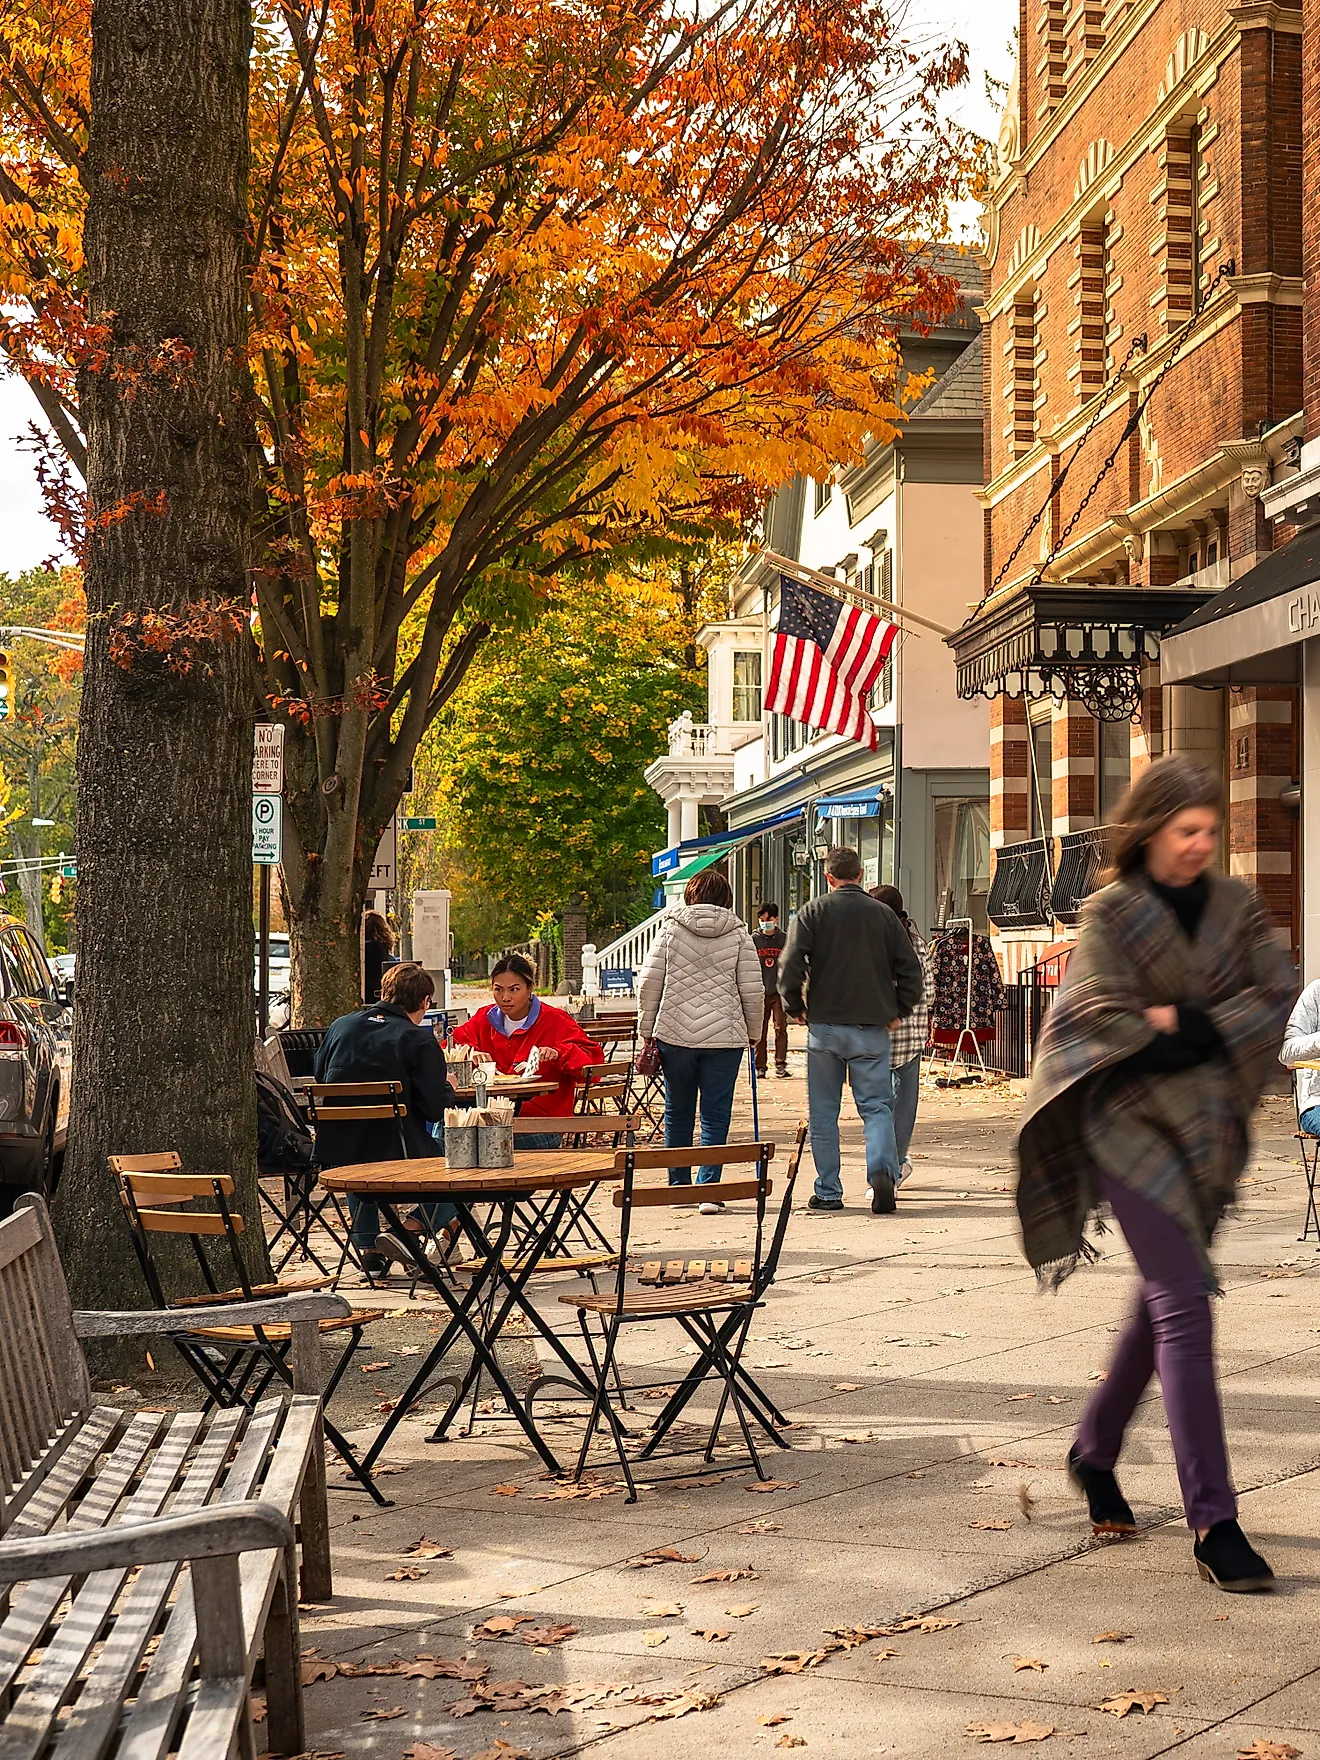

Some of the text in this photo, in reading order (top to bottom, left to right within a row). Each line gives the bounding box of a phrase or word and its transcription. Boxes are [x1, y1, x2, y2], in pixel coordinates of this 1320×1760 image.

[259, 730, 273, 743] NO
[254, 745, 281, 759] ARKING
[271, 759, 279, 769] TO
[252, 770, 278, 780] CORNER
[398, 819, 409, 830] NK
[370, 864, 391, 878] EFT
